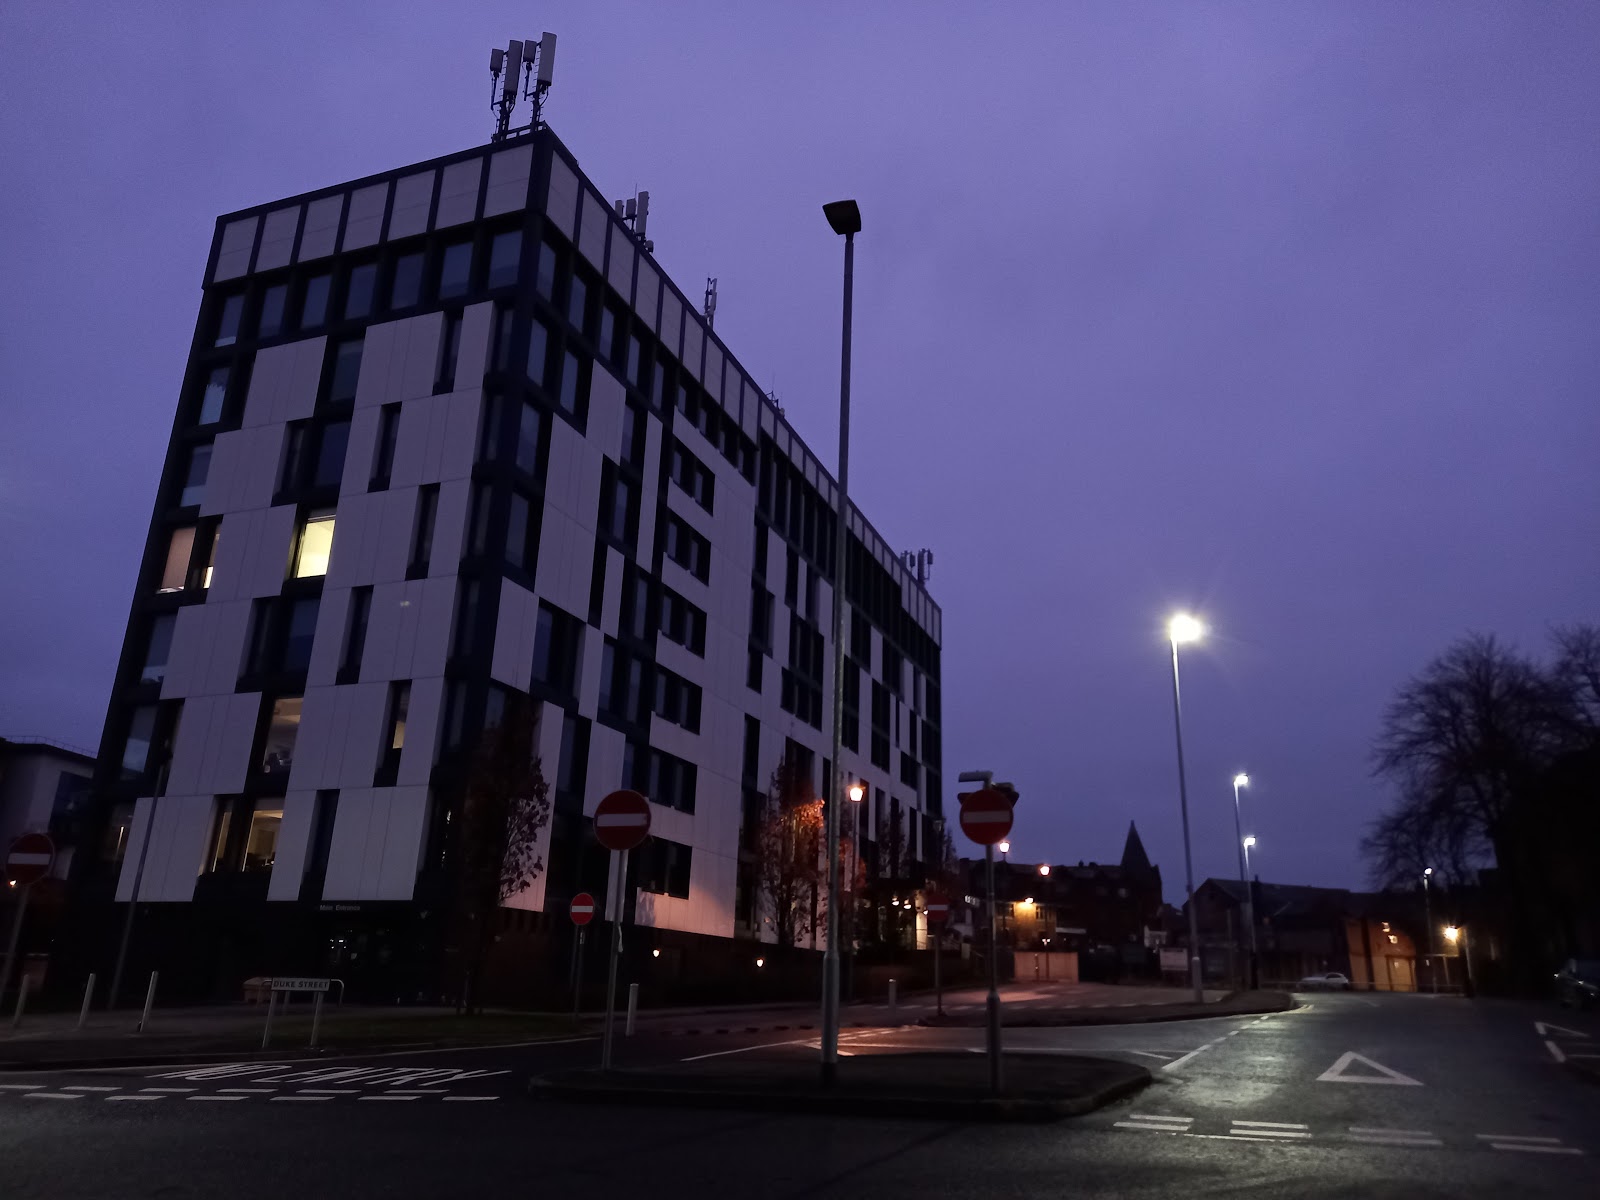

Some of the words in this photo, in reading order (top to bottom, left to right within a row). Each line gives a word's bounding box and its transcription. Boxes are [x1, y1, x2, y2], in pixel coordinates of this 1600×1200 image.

[273, 980, 296, 988] DUKE
[298, 980, 329, 989] STREET
[143, 1064, 290, 1081] NO
[250, 1066, 512, 1087] ENTRY
